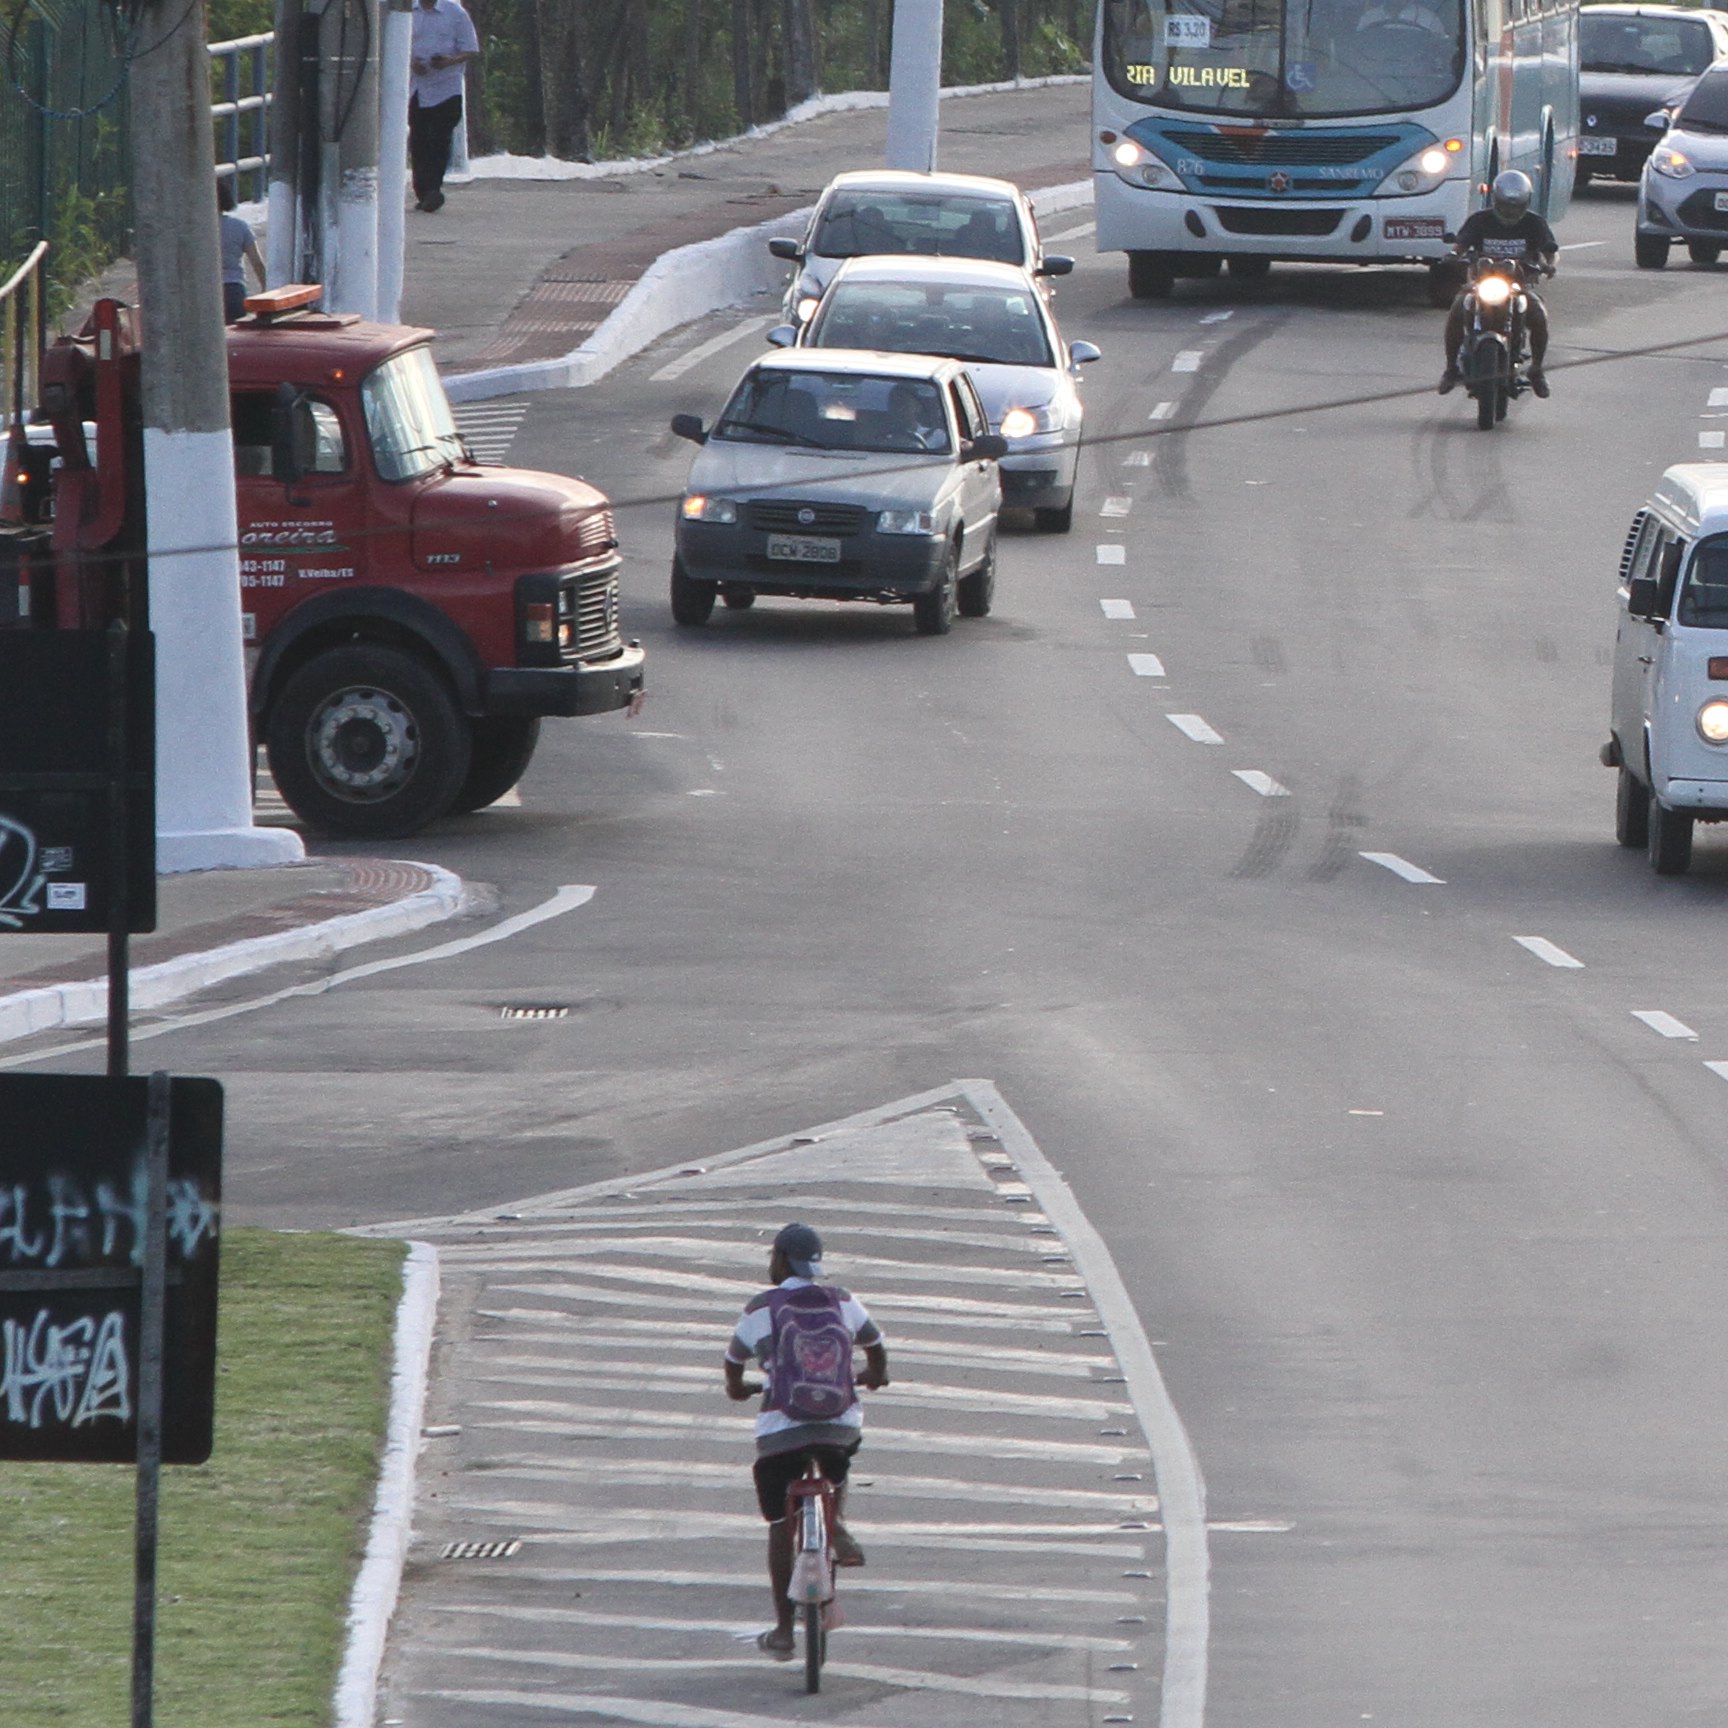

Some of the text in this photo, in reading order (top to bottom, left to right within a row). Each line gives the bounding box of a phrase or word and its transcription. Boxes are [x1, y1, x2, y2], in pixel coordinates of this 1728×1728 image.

[1169, 66, 1214, 86] VILA
[1216, 68, 1250, 88] VEL
[1177, 159, 1204, 176] 876
[1318, 165, 1385, 180] SANREMO
[240, 529, 338, 544] oreira
[239, 560, 286, 572] 43-1147
[239, 574, 285, 587] 05-1147
